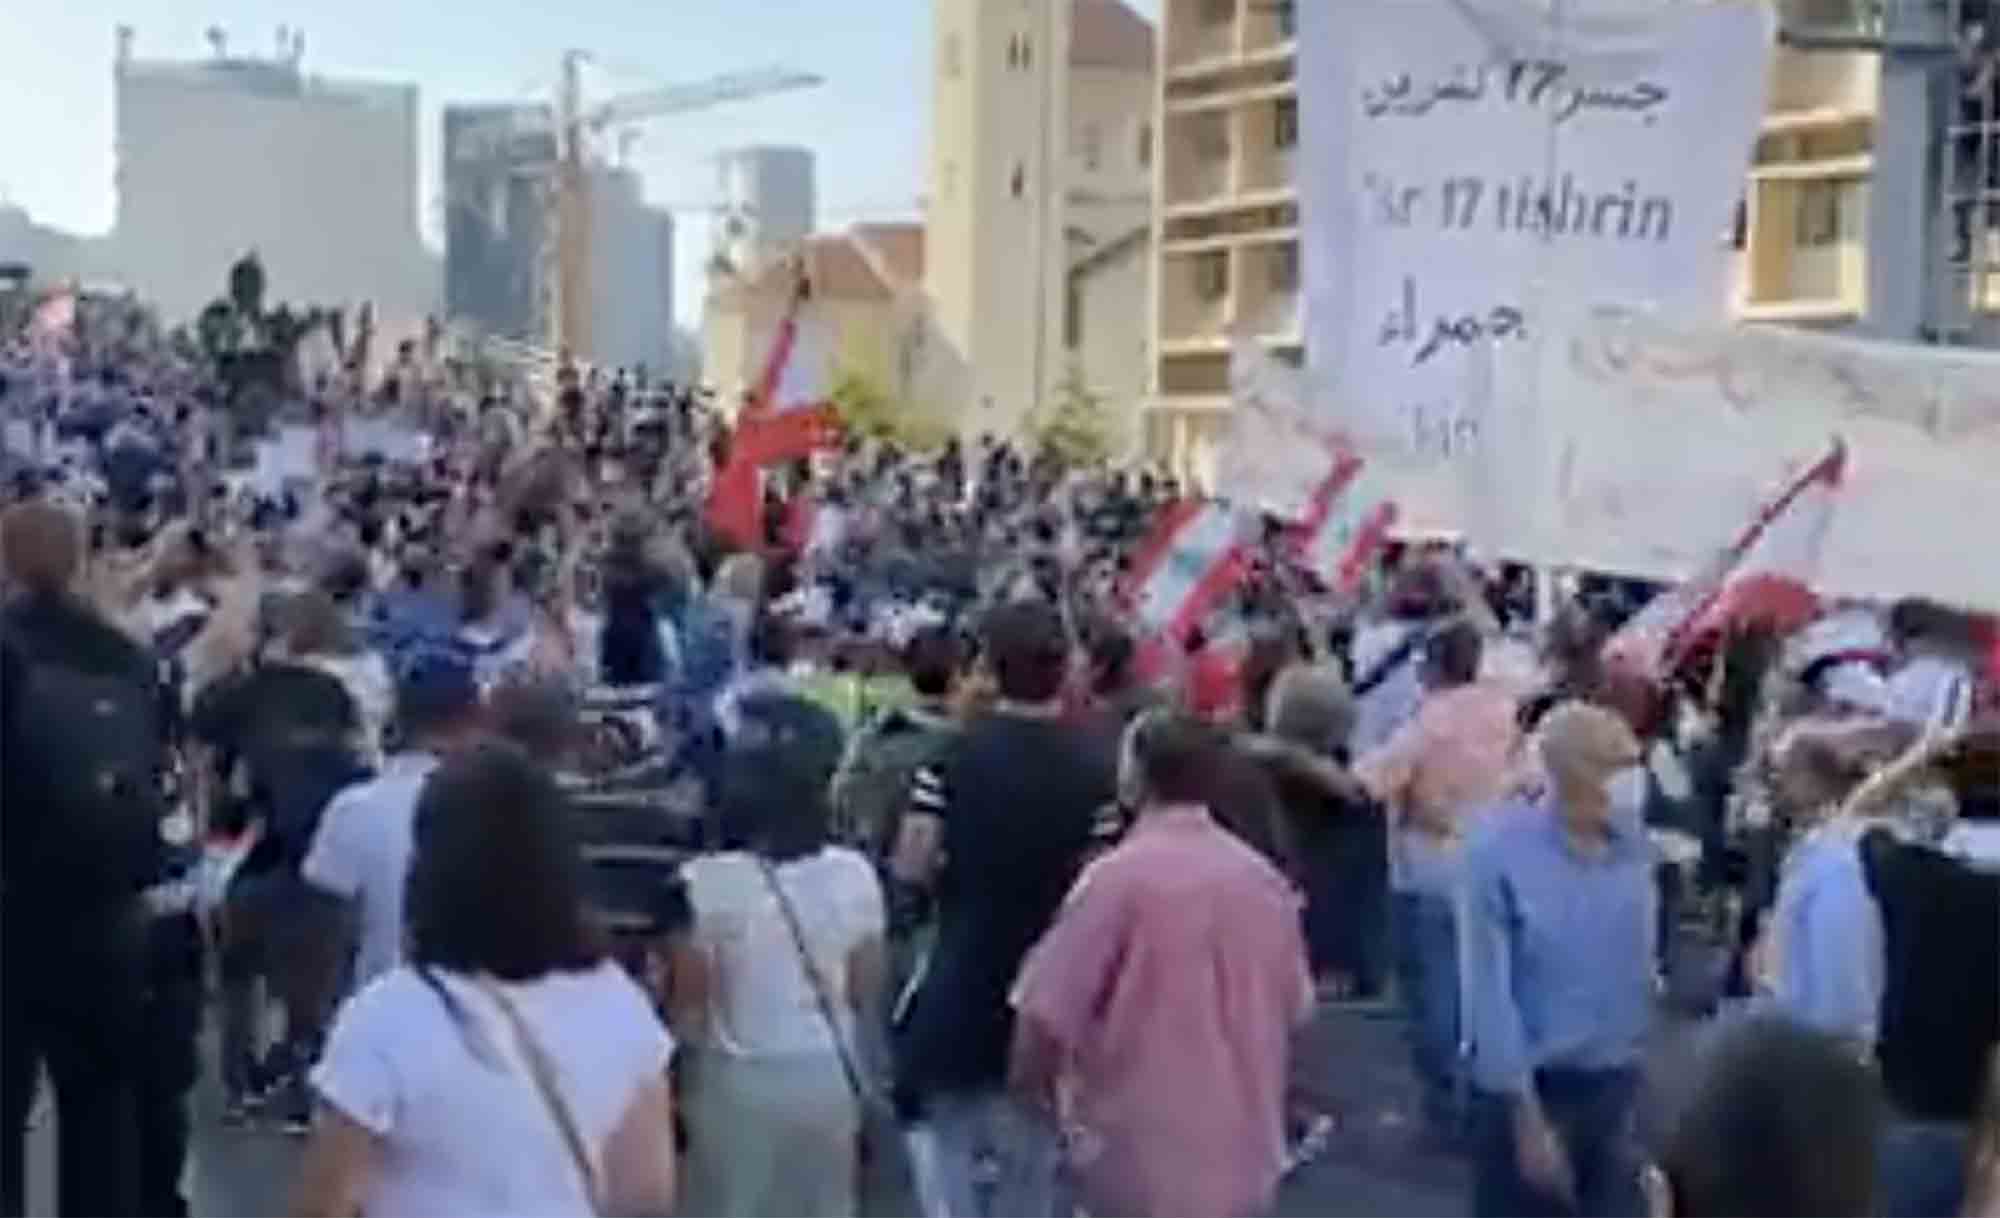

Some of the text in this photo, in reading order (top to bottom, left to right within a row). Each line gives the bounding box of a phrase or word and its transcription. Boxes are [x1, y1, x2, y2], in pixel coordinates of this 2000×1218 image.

[1504, 59, 1568, 103] 17
[1552, 80, 1668, 126] جسر
[1443, 178, 1484, 229] 17
